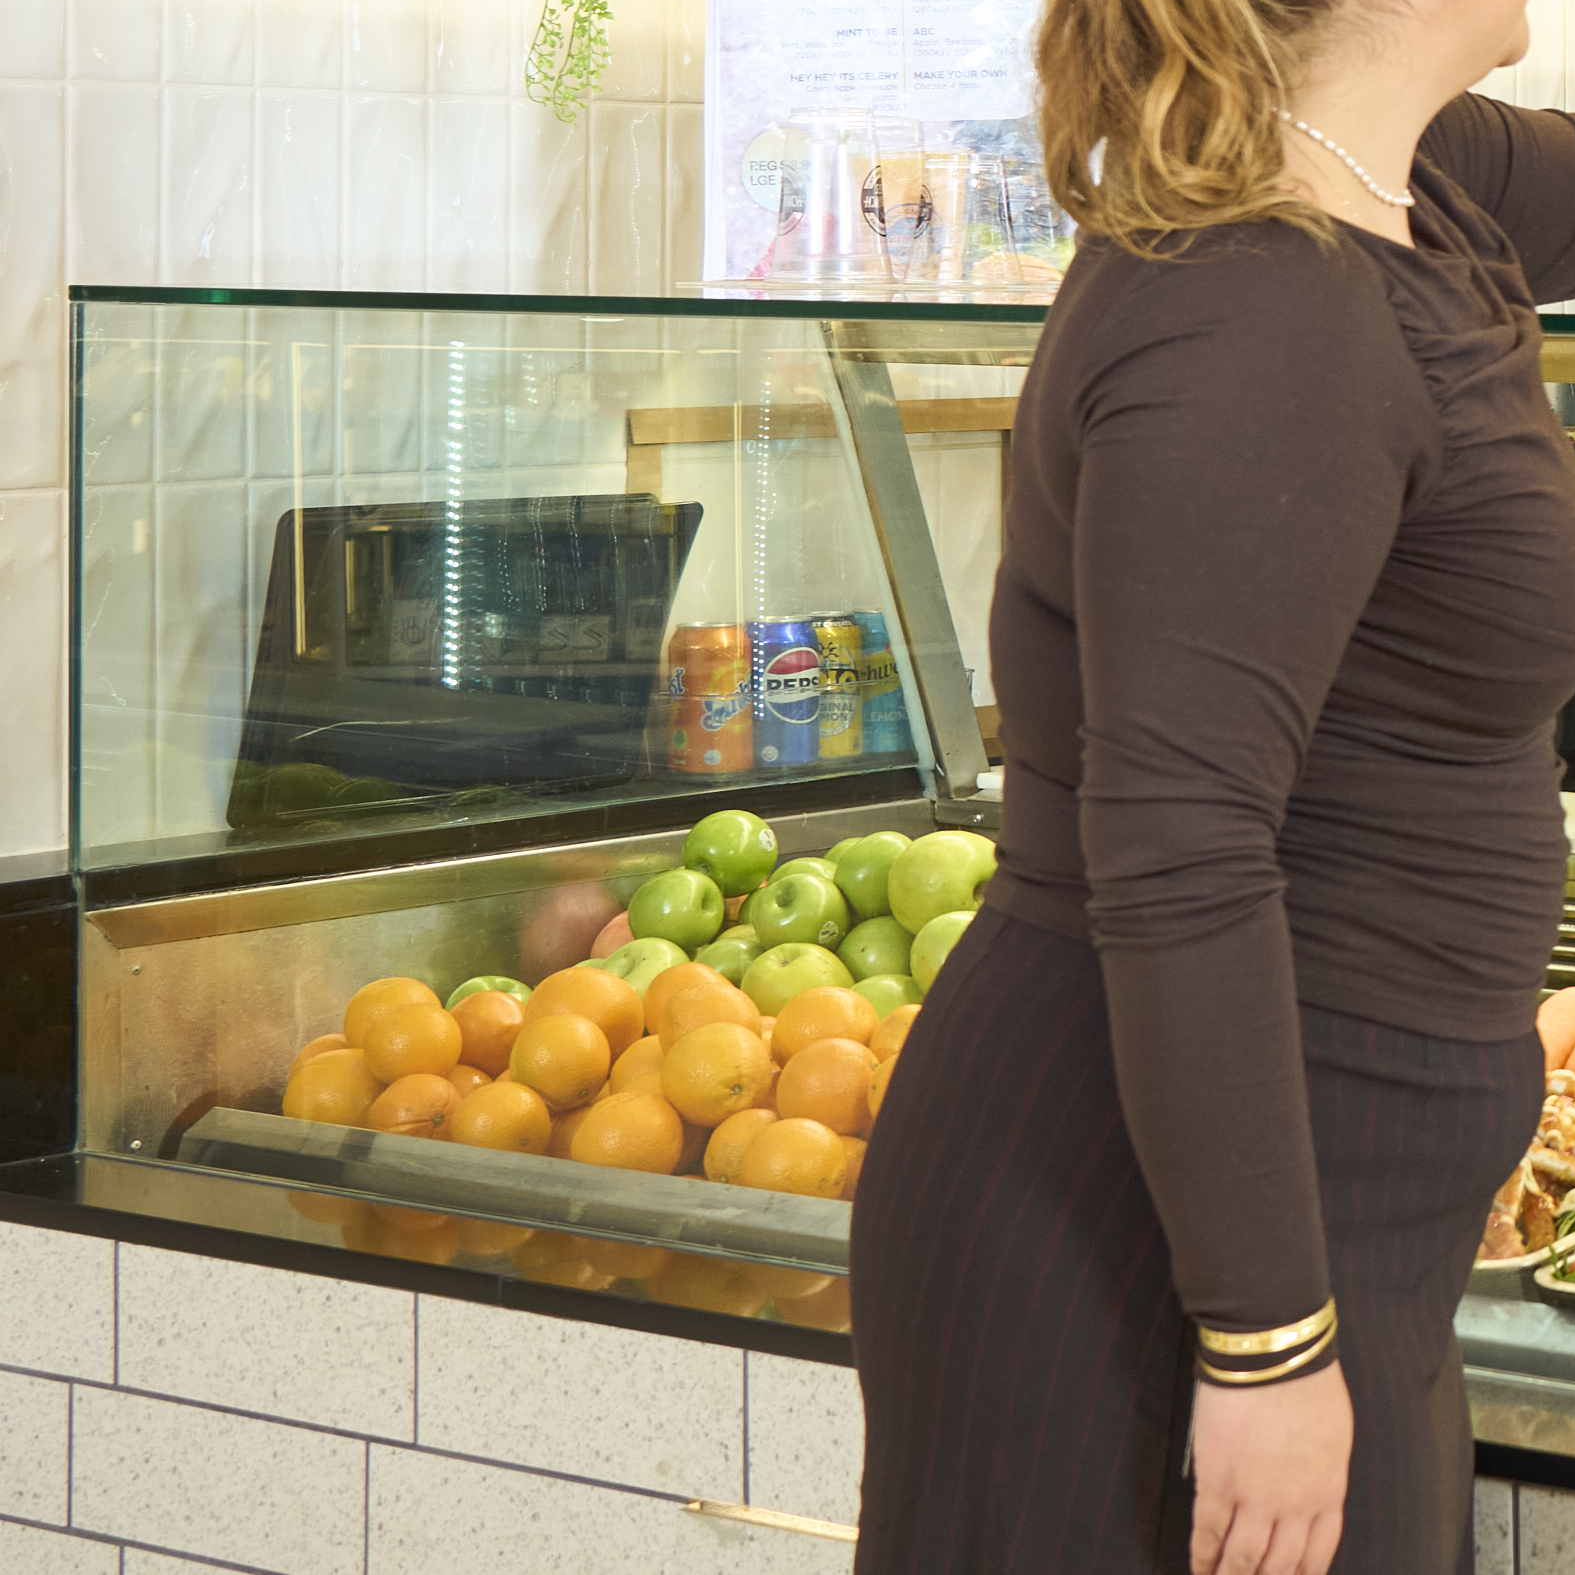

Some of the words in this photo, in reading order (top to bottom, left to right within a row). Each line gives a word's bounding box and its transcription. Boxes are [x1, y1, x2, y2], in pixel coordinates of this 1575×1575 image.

[913, 27, 935, 36] ABC
[914, 70, 945, 80] MAKE
[948, 70, 979, 79] YOUR
[981, 69, 1008, 78] OWN
[766, 677, 820, 691] PEPS
